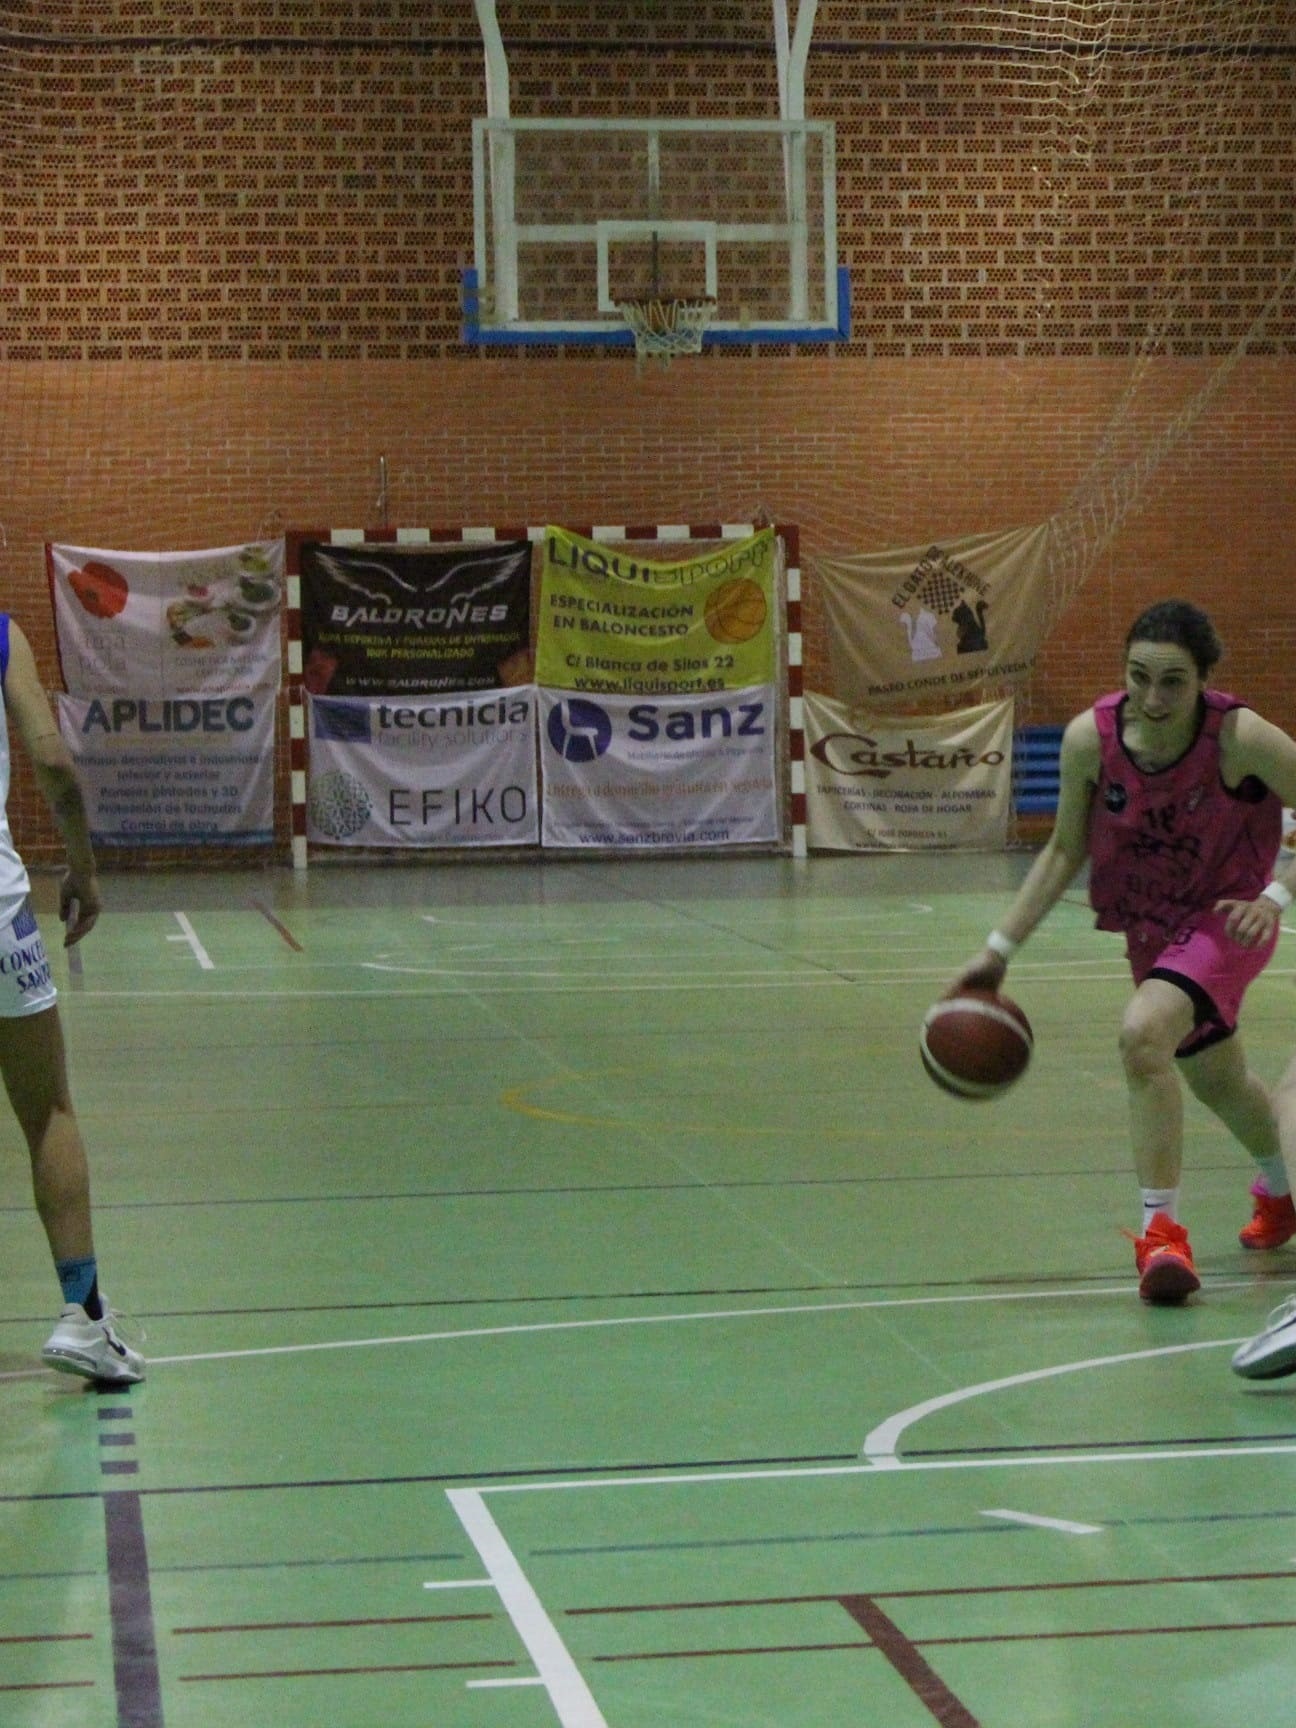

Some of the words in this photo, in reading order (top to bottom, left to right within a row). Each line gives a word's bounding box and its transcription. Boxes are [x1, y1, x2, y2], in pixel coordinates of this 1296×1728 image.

[331, 602, 509, 630] BALDRONES
[553, 615, 575, 628] EN
[579, 617, 689, 637] BALONCESTO
[586, 655, 642, 672] Blanca
[646, 657, 669, 672] de
[673, 657, 709, 672] Silos
[714, 655, 734, 669] 22
[82, 697, 255, 733] APLIDEC
[378, 697, 528, 729] tecnicia
[628, 703, 765, 741] Sanz
[809, 733, 1004, 779] Castaño
[390, 786, 527, 826] EFIKO
